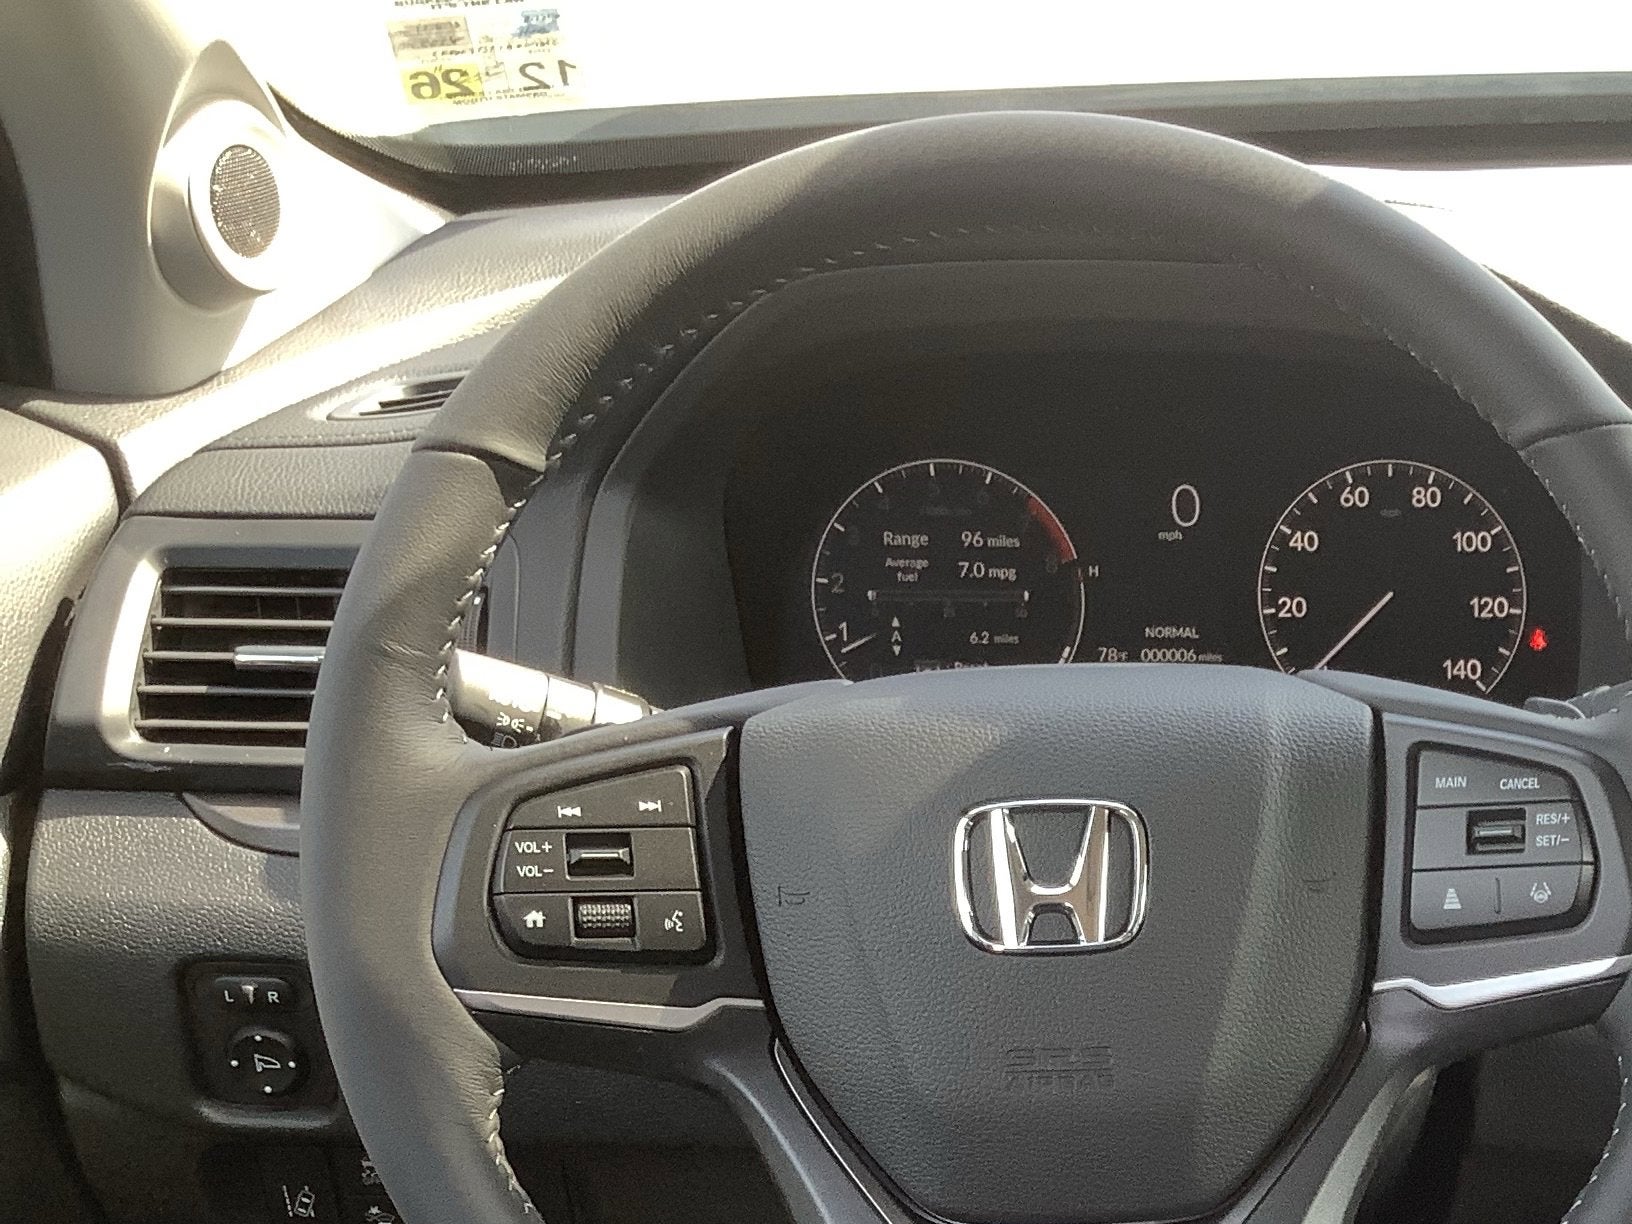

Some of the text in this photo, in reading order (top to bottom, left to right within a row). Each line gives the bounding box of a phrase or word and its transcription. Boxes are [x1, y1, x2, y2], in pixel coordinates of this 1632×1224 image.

[1340, 487, 1370, 508] 60
[1412, 487, 1441, 508] 80
[1172, 484, 1200, 527] 0
[883, 531, 1021, 548] Range 96 miles
[1158, 530, 1183, 541] mph
[1289, 531, 1319, 551] 40
[1452, 531, 1492, 551] 100
[885, 557, 929, 571] Average
[897, 571, 919, 583] fuel
[958, 562, 1017, 581] 7.0 mpg
[1089, 566, 1099, 577] H
[831, 573, 844, 593] 2
[1278, 596, 1307, 618] 20
[1470, 596, 1509, 618] 120
[838, 622, 848, 641] 1
[969, 631, 1019, 644] 6.2 miles
[1145, 626, 1199, 639] NORMAL
[1141, 648, 1197, 662] 000006
[1198, 653, 1223, 662] miles
[1443, 659, 1481, 680] 140
[1435, 776, 1467, 788] MAIN
[1499, 778, 1540, 790] CANCEL
[1536, 813, 1571, 825] RES/+
[515, 841, 552, 853] VOL+
[224, 990, 234, 1002] L
[268, 991, 280, 1003] R
